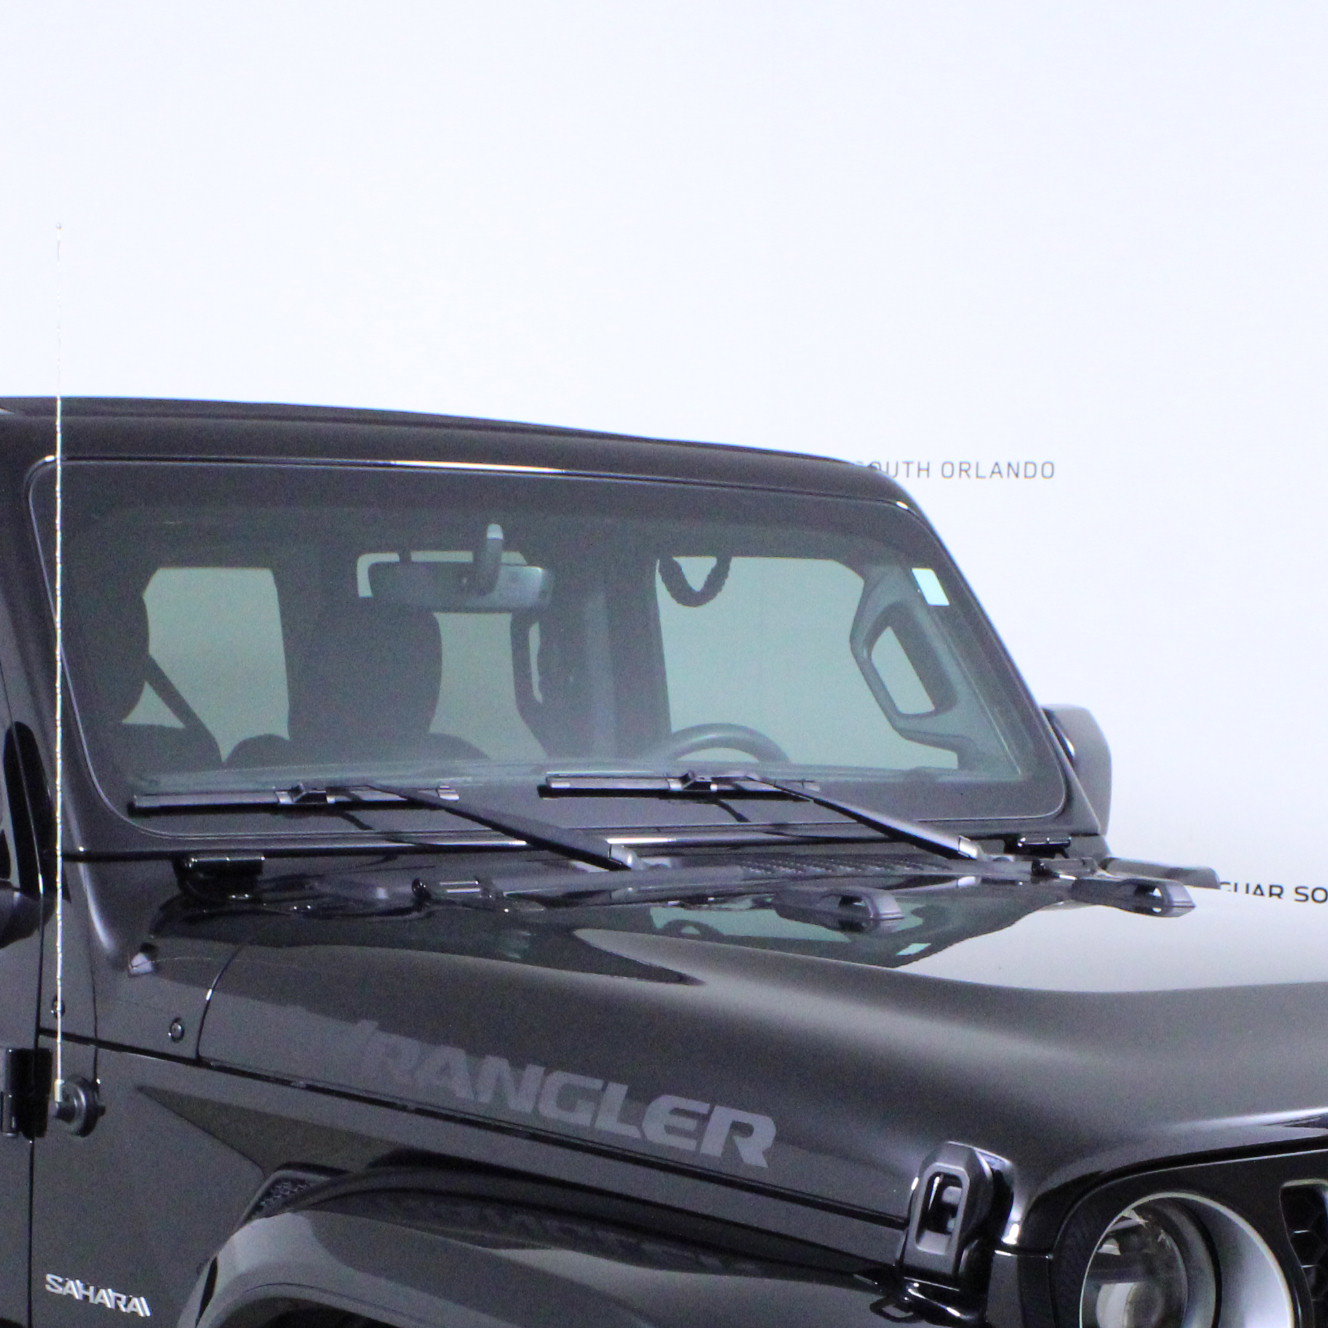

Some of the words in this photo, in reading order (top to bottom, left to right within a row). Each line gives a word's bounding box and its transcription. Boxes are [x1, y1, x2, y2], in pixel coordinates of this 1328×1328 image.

[941, 460, 1055, 479] ORLANDO
[312, 1008, 778, 1169] RANGLER
[45, 1273, 151, 1318] SAHARA
